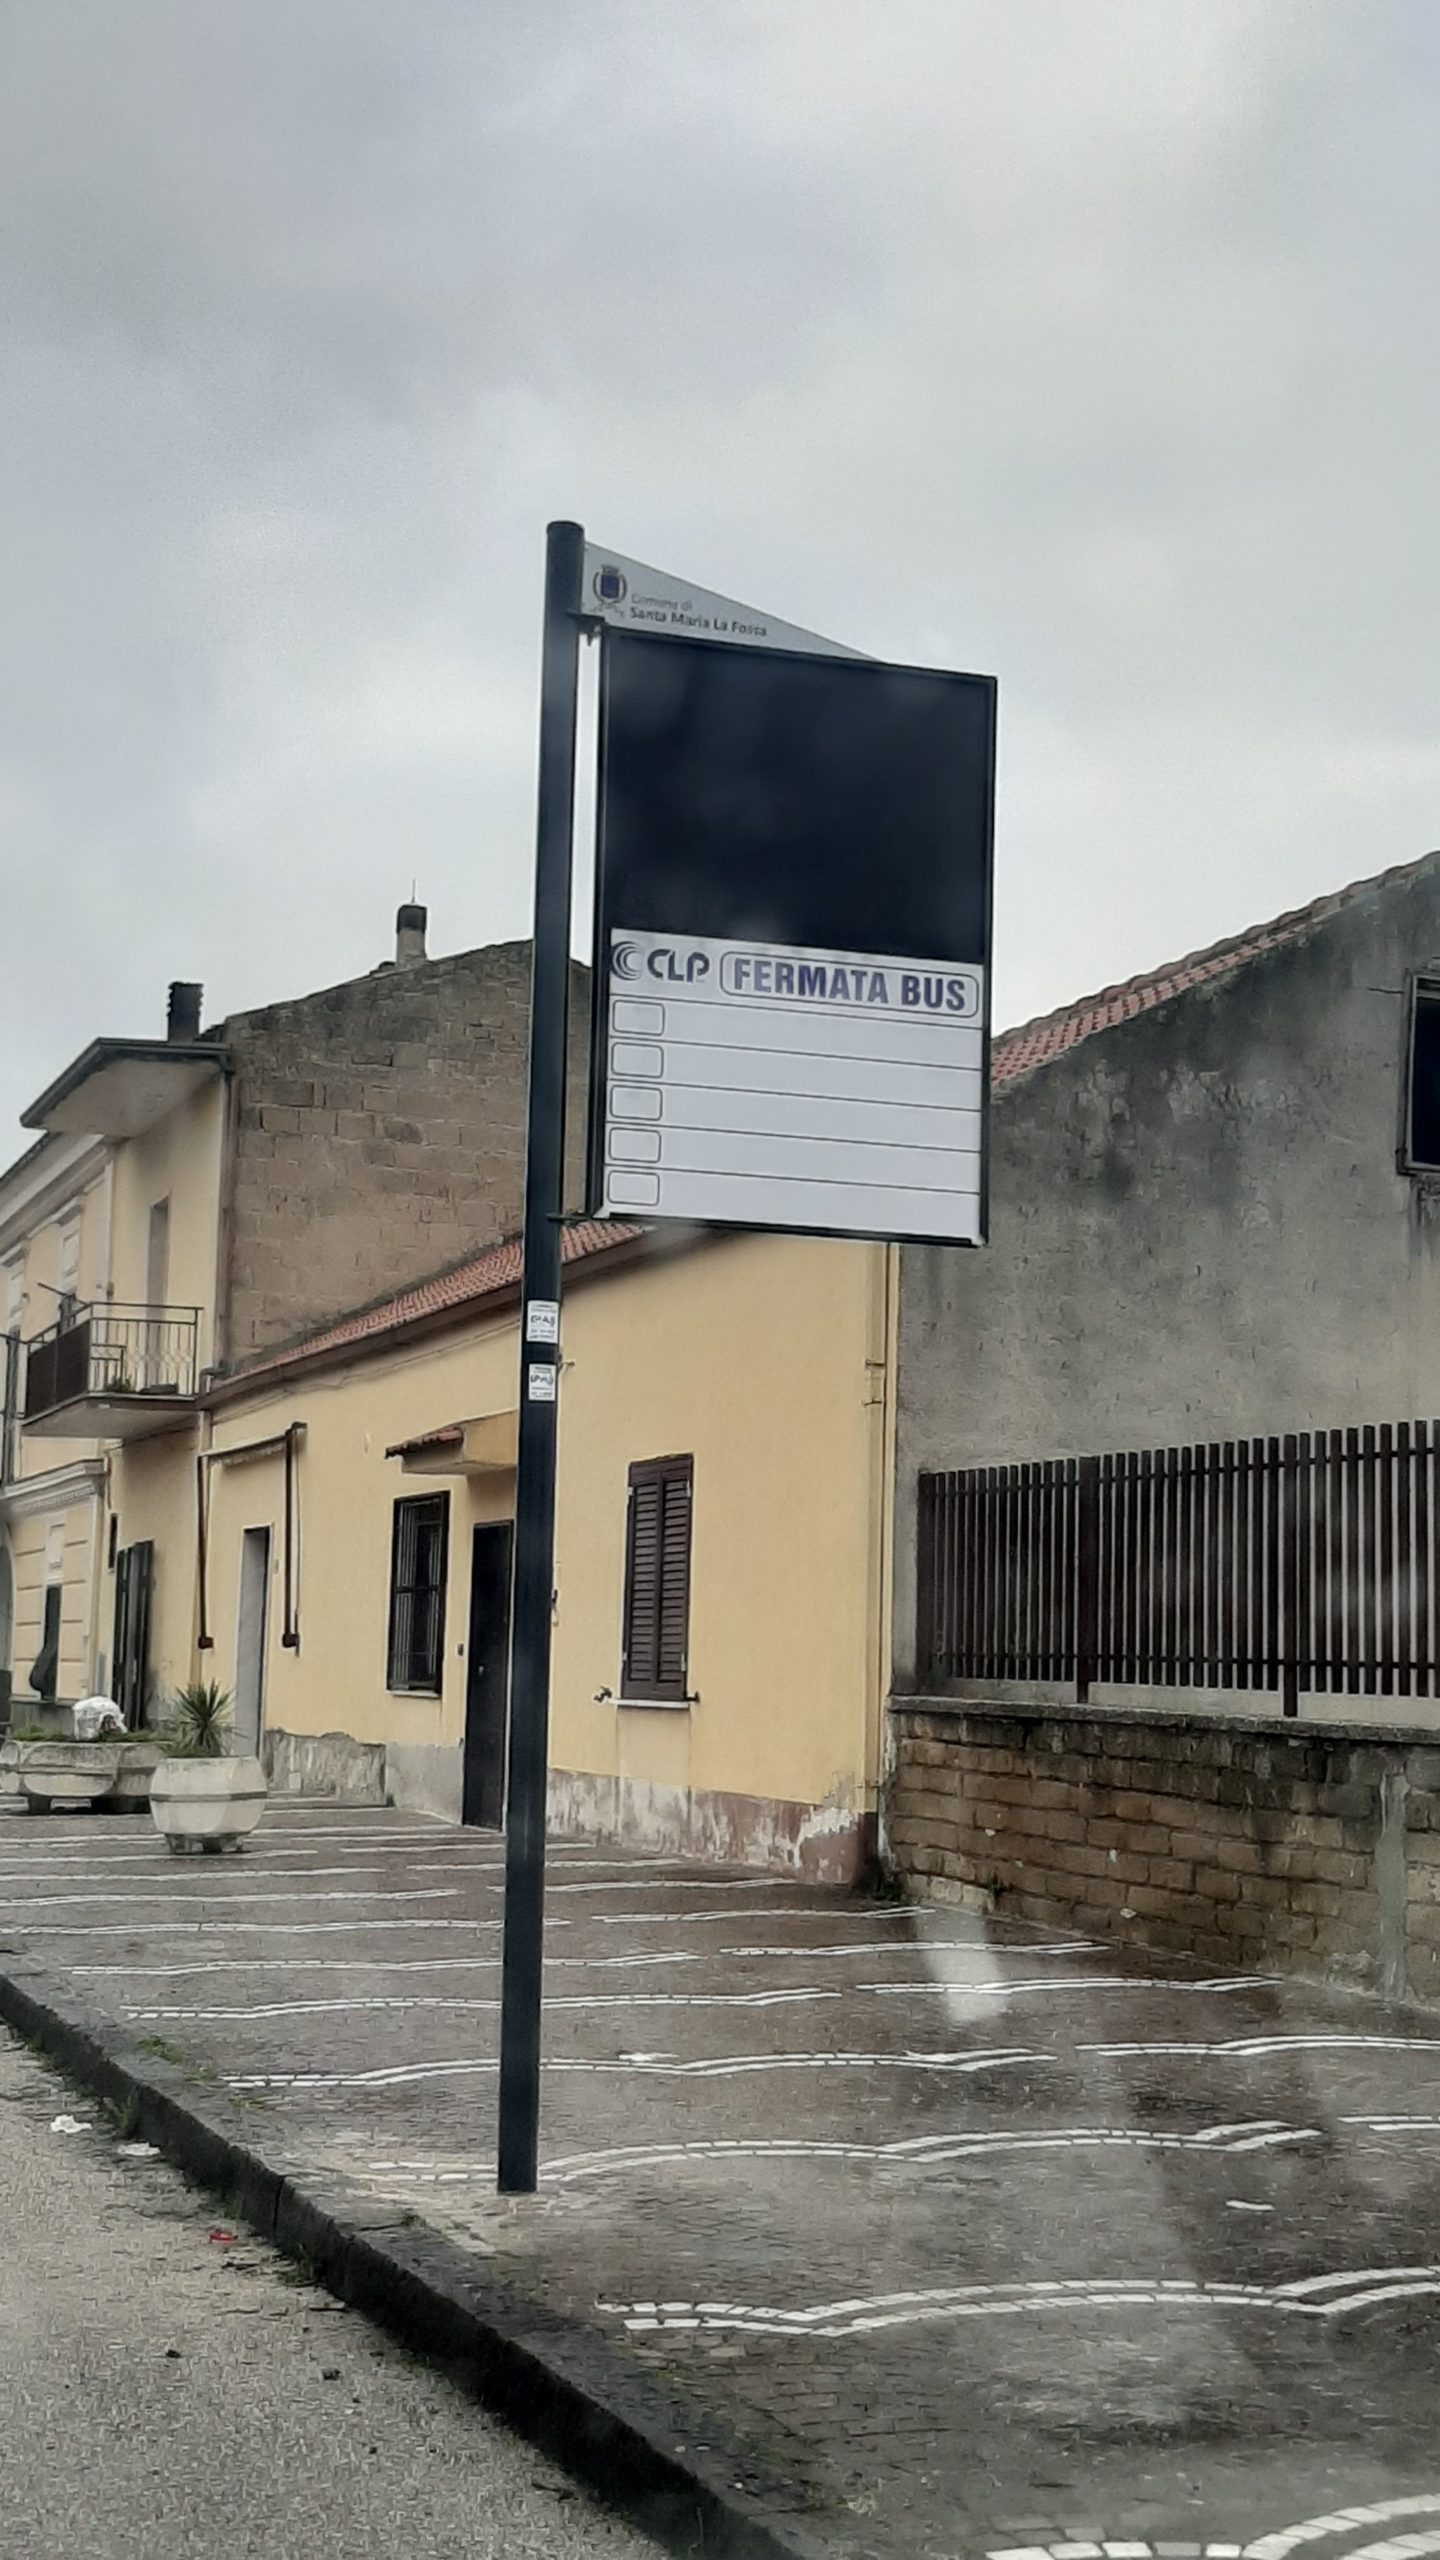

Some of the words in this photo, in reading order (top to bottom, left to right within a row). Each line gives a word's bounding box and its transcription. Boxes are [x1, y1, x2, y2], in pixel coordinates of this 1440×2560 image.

[630, 606, 667, 623] Santa
[671, 612, 710, 629] Maria
[714, 618, 728, 631] La
[647, 948, 710, 983] CLP
[734, 957, 889, 1003] FERMATA
[901, 975, 966, 1011] BUS
